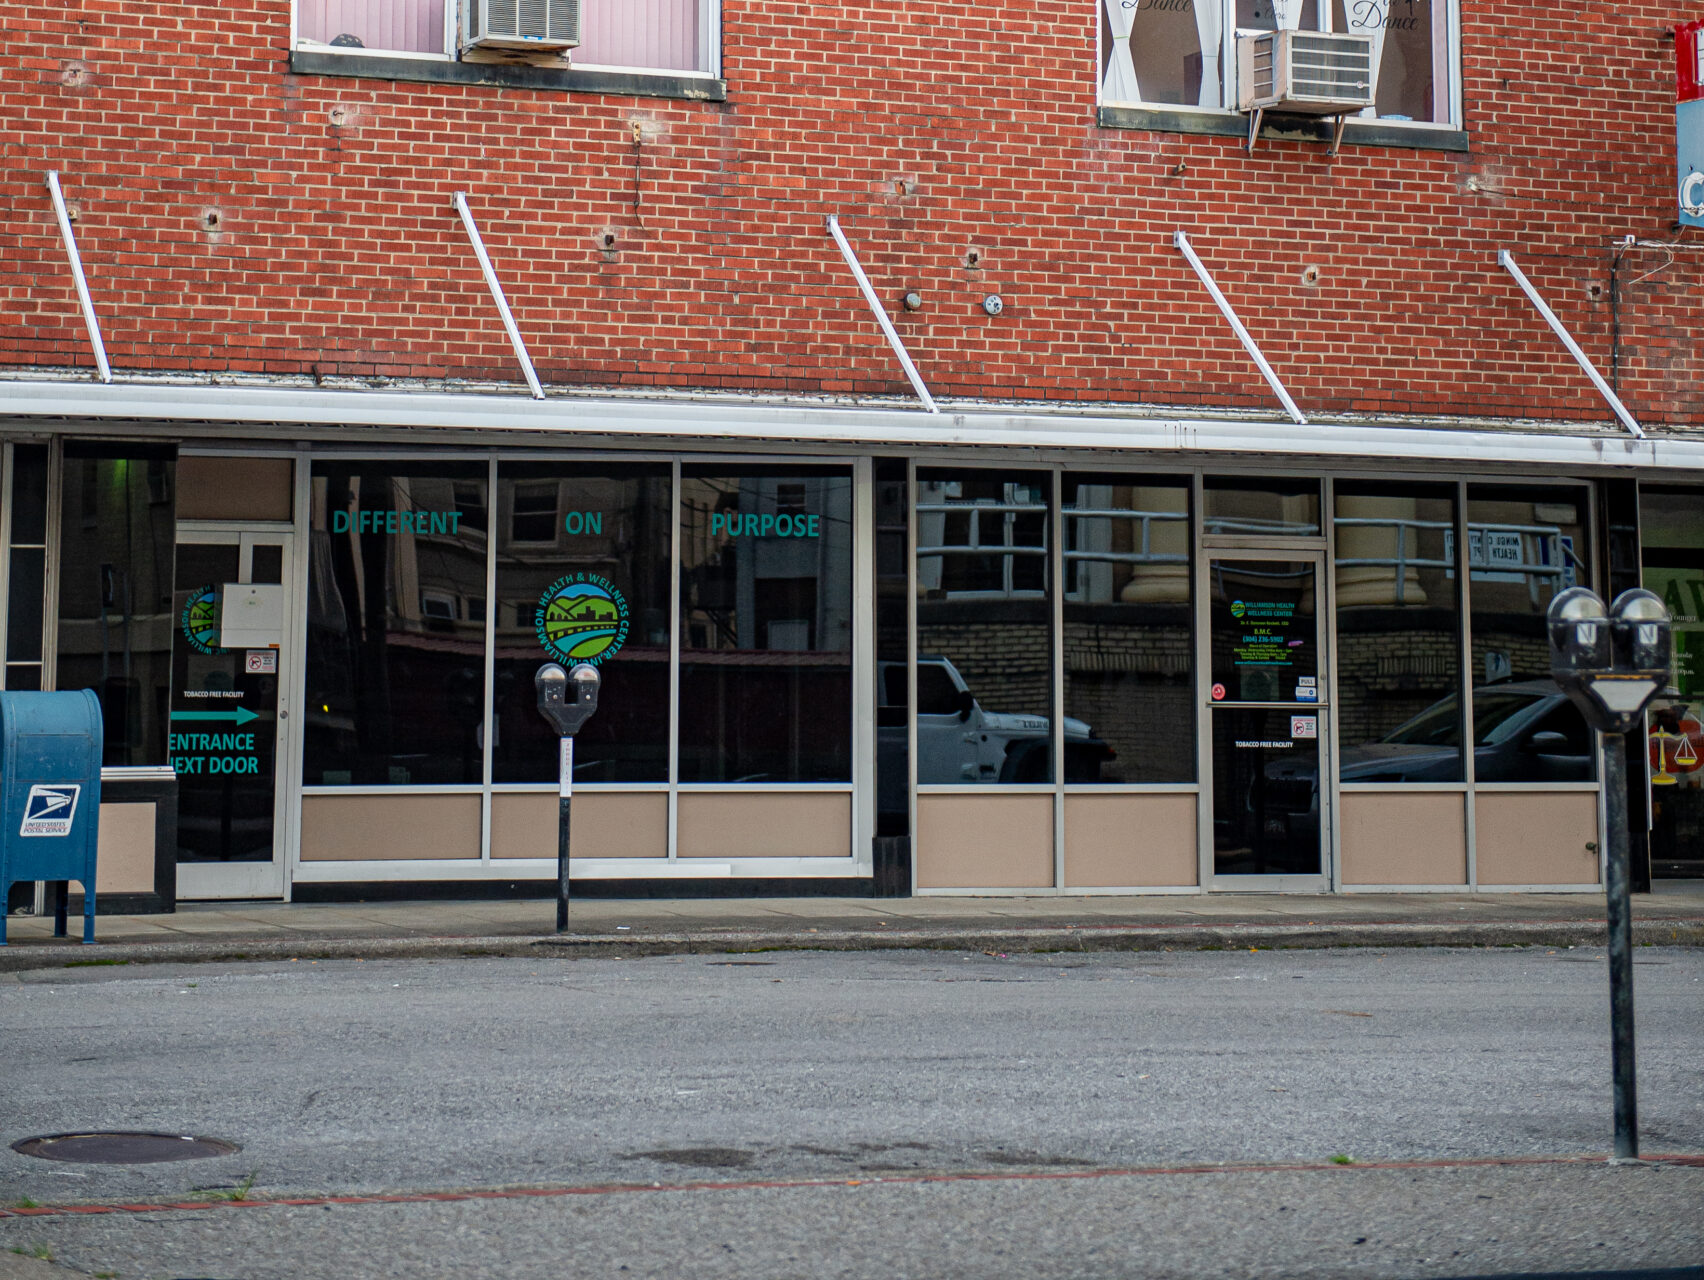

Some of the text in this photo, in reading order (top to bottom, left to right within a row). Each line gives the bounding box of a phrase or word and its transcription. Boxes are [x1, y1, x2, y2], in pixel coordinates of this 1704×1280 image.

[1352, 0, 1418, 31] Dance
[333, 510, 820, 538] DIFFERENT ON PURPOSE
[539, 575, 574, 607] HEALTH
[576, 572, 585, 582] &
[589, 573, 630, 617] WELLNESS
[535, 609, 578, 667] WILLIAMSON
[183, 690, 244, 698] TOBACCO FREE FACILITY
[168, 733, 255, 751] ENTRANCE
[209, 756, 259, 774] DOOR
